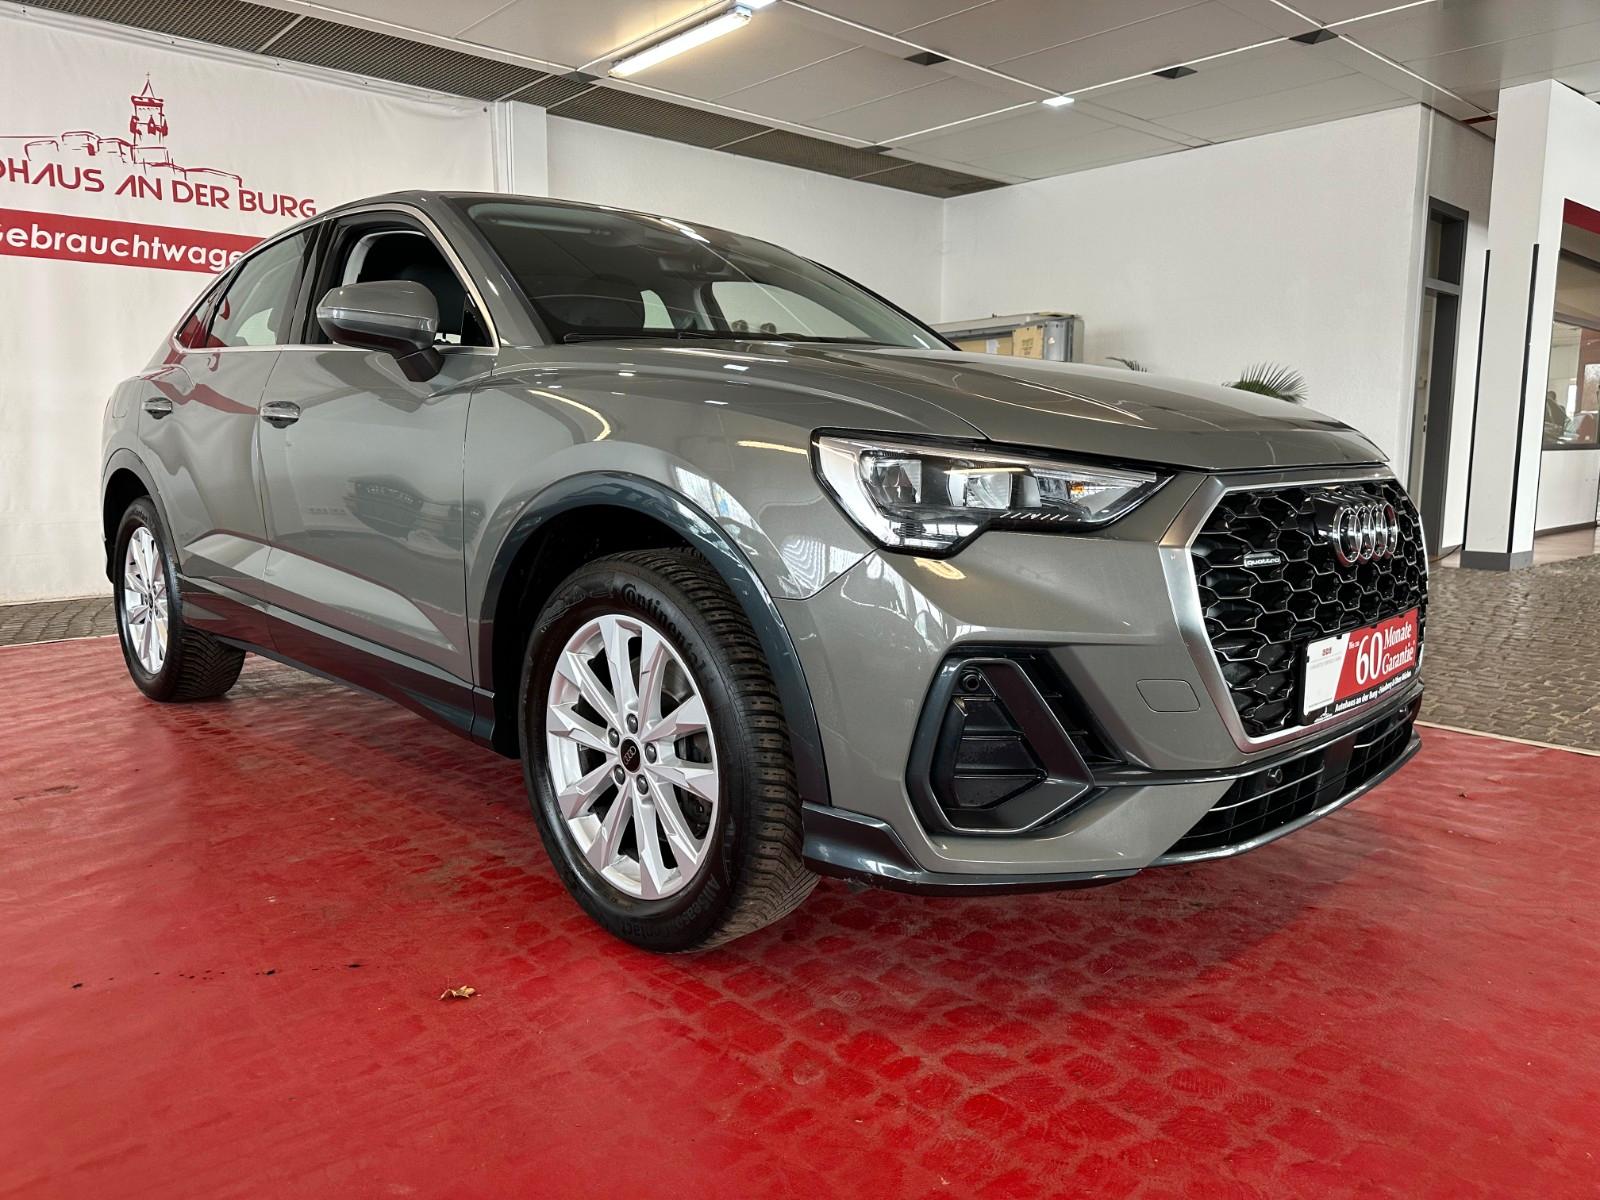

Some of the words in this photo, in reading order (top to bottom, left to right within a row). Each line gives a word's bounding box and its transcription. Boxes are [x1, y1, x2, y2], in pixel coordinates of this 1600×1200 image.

[115, 174, 163, 201] AN
[172, 180, 230, 209] DER
[239, 189, 316, 218] BURG
[0, 223, 243, 272] ebrauchtwag
[1246, 557, 1280, 567] quattro
[1383, 621, 1412, 650] Monate
[1356, 632, 1383, 685] 60
